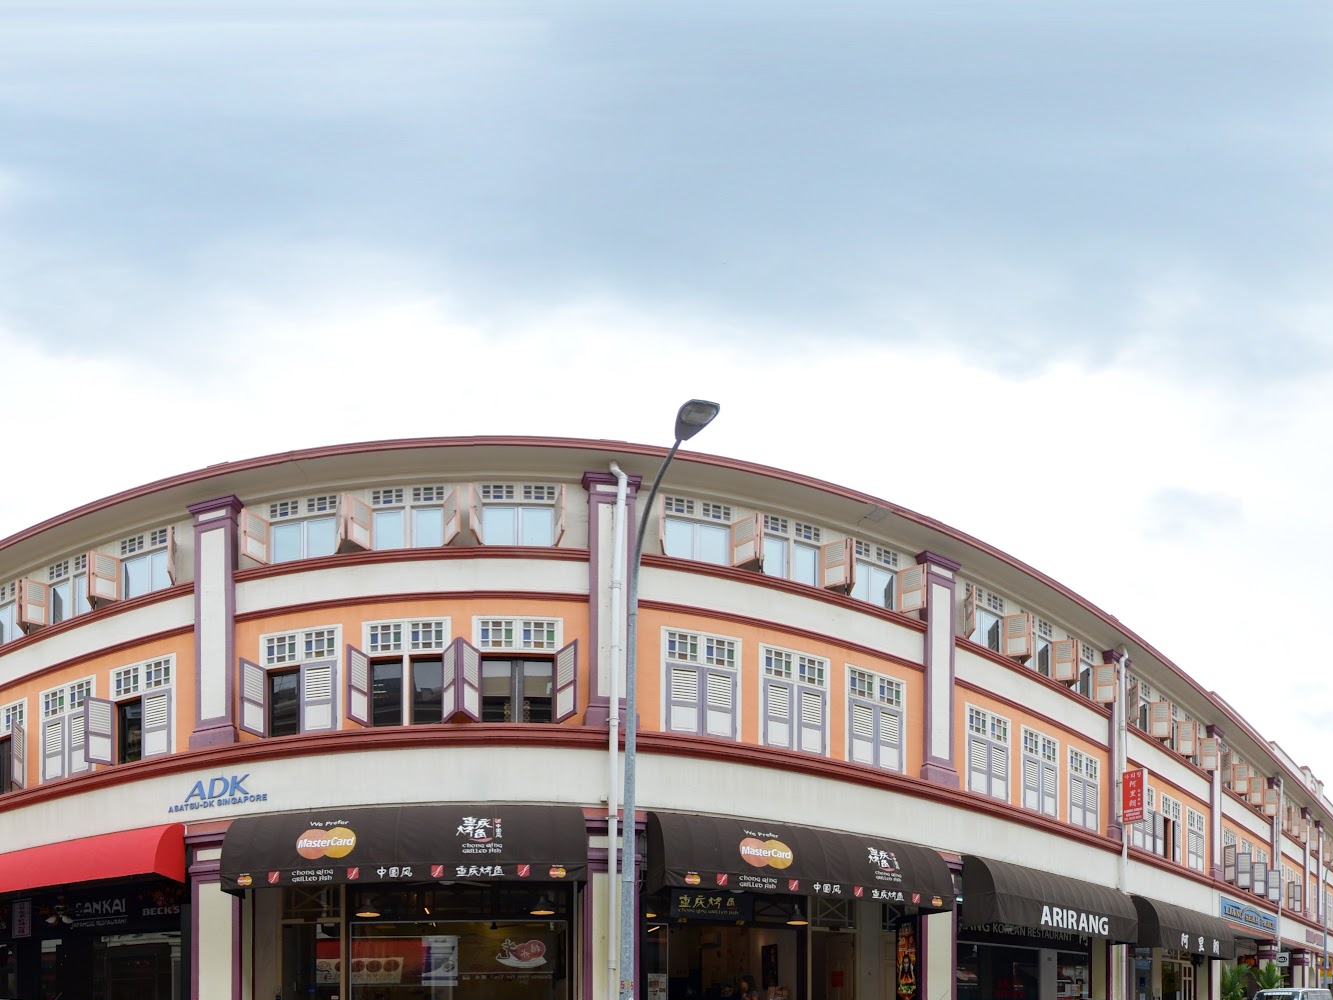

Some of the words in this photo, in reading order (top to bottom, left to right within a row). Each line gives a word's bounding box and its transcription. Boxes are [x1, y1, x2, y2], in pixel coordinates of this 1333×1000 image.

[184, 774, 250, 803] ADK
[217, 793, 268, 807] SINGAPORE
[297, 837, 355, 849] MasterCard
[741, 846, 791, 860] MasterCard
[376, 866, 413, 879] 中国风
[456, 865, 505, 877] 重庆烤鱼
[813, 882, 841, 894] 中国风
[872, 888, 905, 901] 重庆烤鱼
[142, 905, 180, 916] BECK'S
[1040, 905, 1109, 935] ARIRANG
[1027, 927, 1073, 942] RESTAURANT
